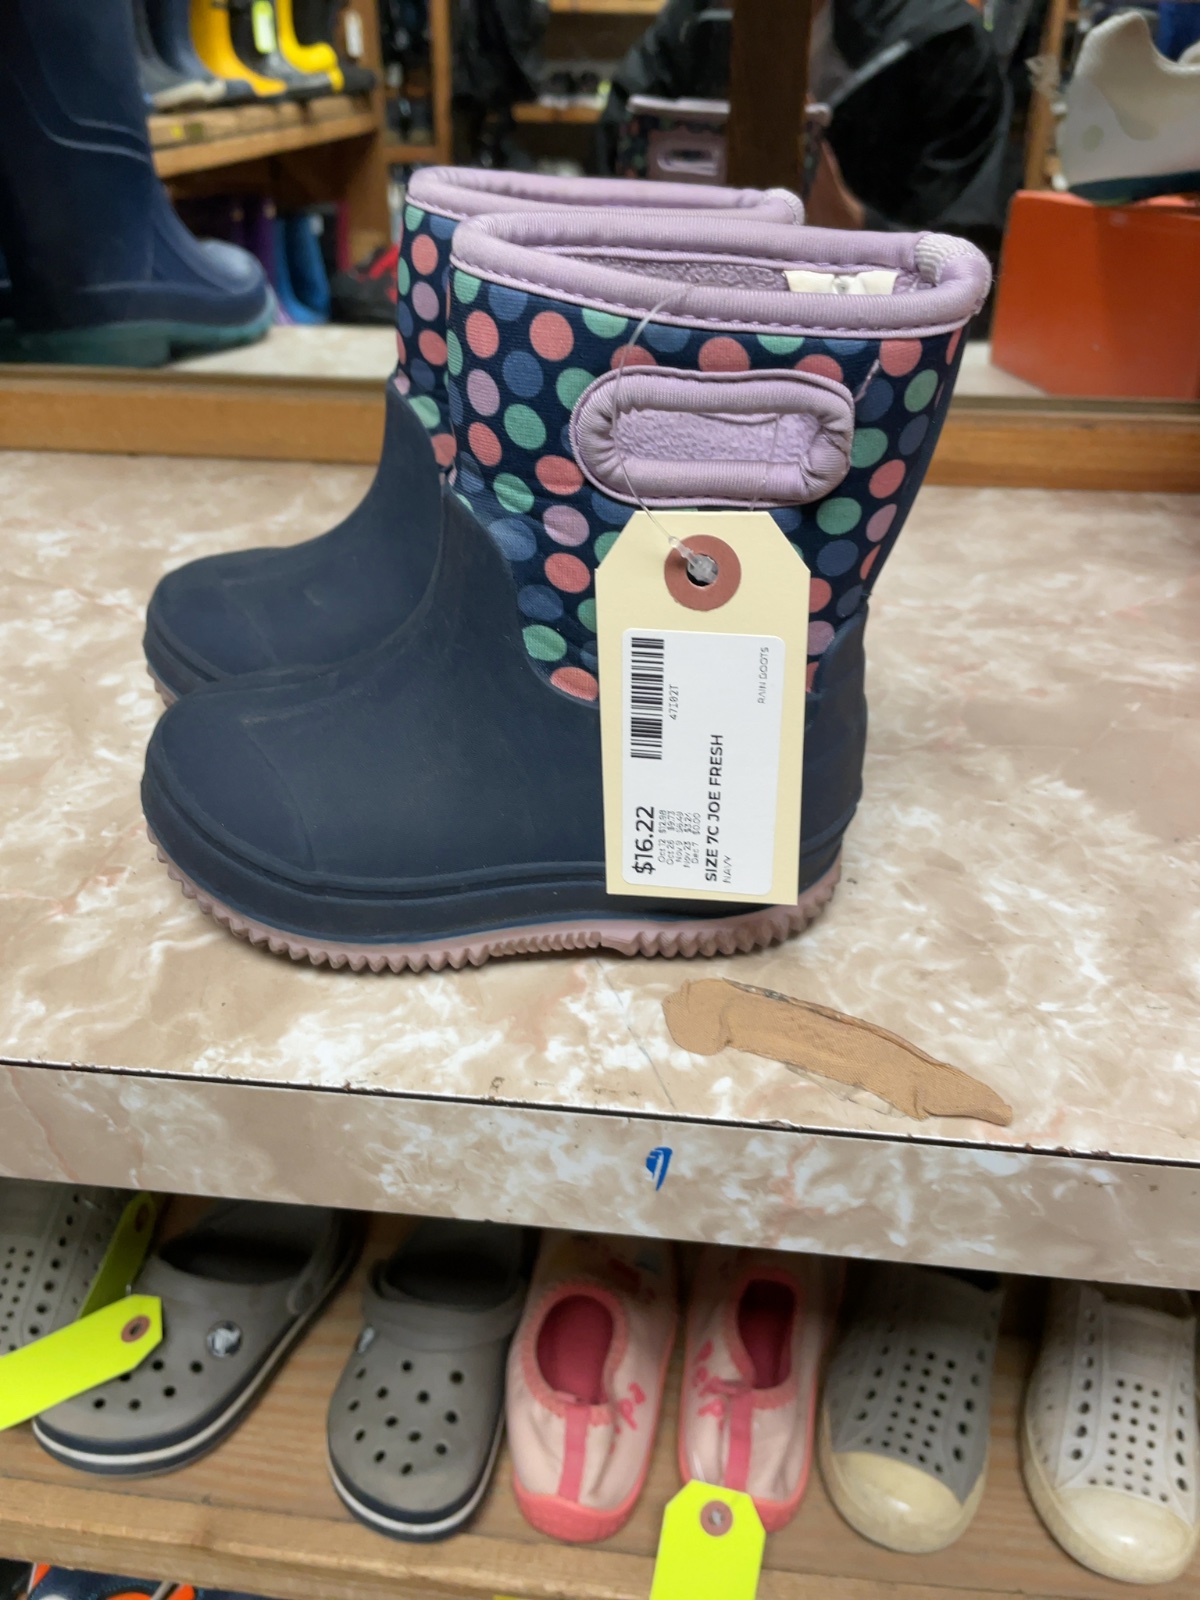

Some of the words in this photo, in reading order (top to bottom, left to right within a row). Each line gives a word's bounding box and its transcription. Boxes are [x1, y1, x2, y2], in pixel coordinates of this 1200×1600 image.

[757, 682, 767, 704] RAIN
[709, 734, 724, 787] FRESH
[707, 791, 721, 822] JOE
[691, 812, 701, 835] $0.00
[706, 825, 720, 844] 7C
[632, 806, 656, 875] $16.22
[658, 838, 666, 847] 12
[657, 848, 666, 863] Oct
[666, 850, 675, 865] Oct
[675, 847, 683, 862] Nov
[691, 848, 699, 864] Dec
[705, 848, 719, 881] SIZE
[722, 855, 733, 884] NAVY
